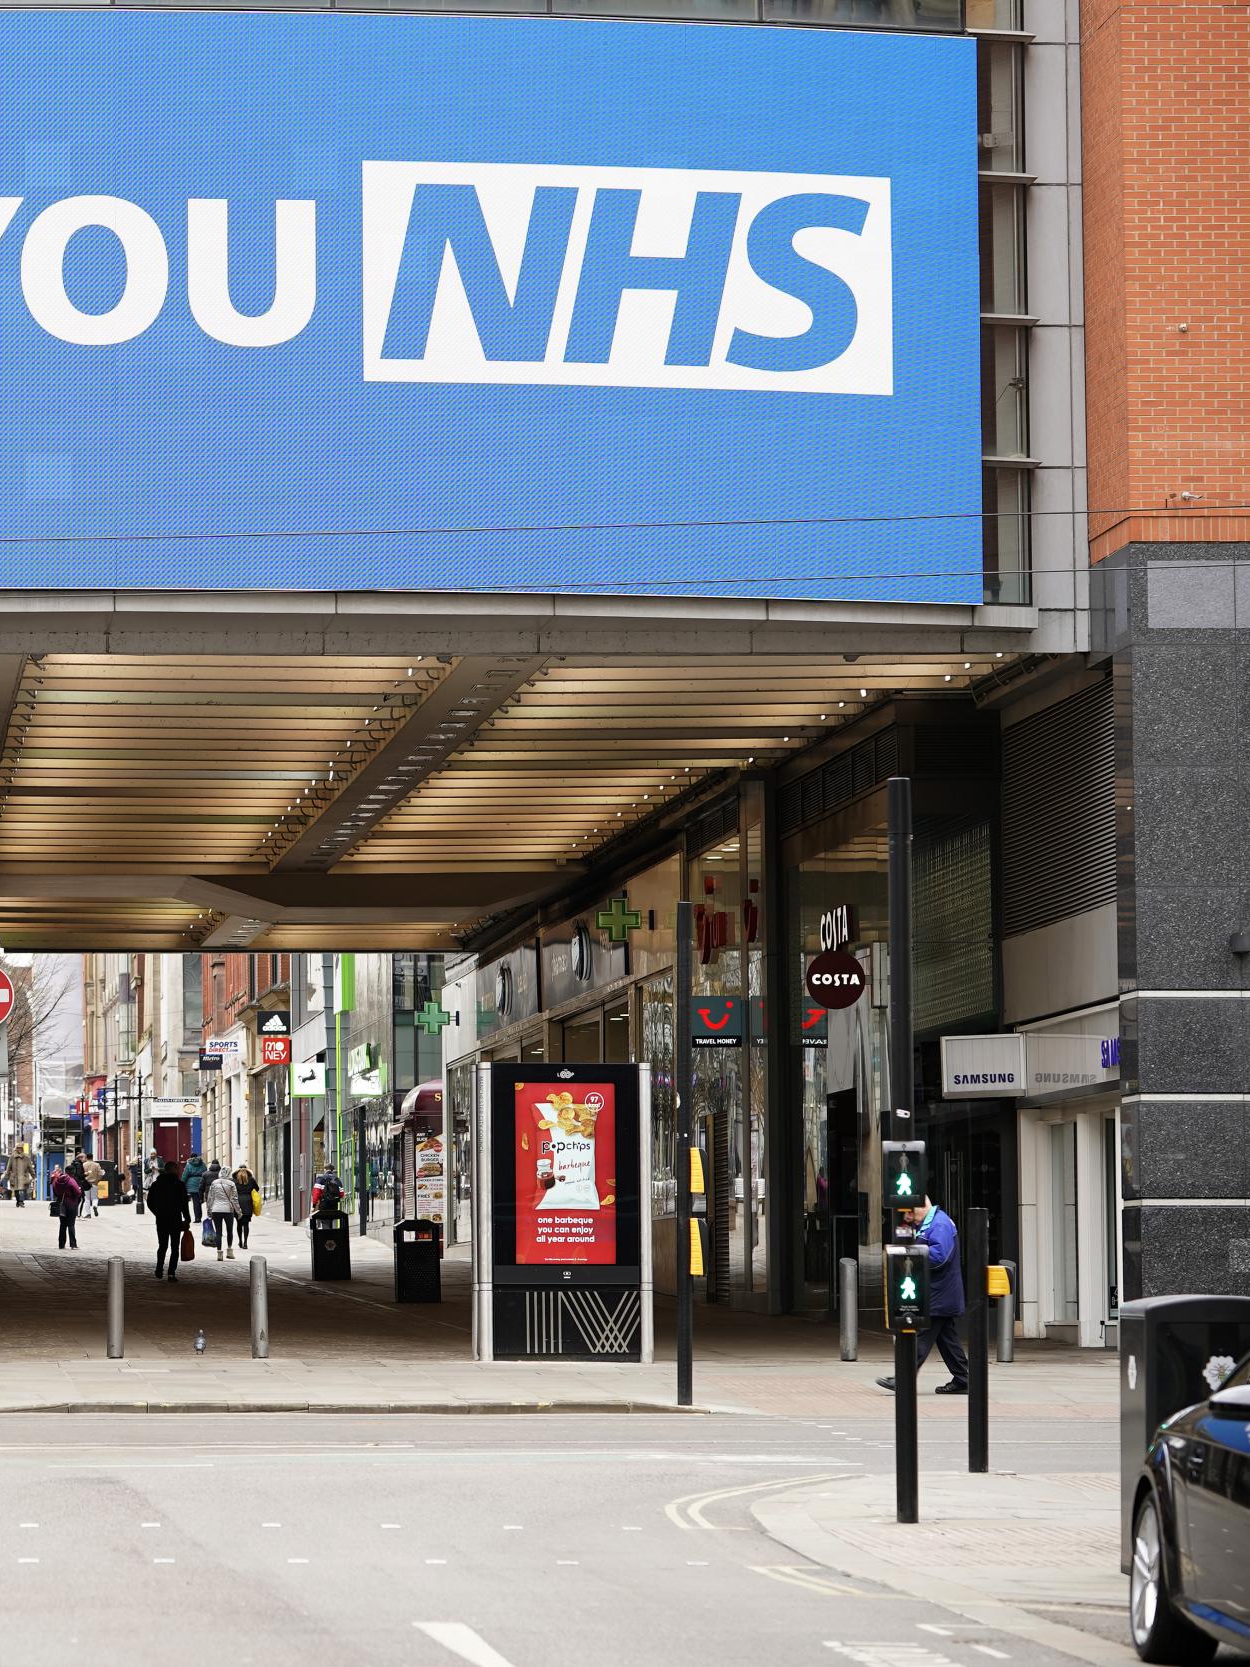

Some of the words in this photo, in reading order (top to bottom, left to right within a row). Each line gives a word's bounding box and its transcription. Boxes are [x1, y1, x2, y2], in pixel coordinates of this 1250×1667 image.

[378, 182, 871, 373] NHS
[819, 904, 849, 951] COSTA
[811, 973, 861, 987] COSTA
[953, 1073, 1015, 1085] SAMSUNG
[558, 1159, 591, 1174] barbeque
[554, 1216, 593, 1226] barbeque
[537, 1226, 553, 1235] you
[571, 1226, 593, 1235] enjoy
[536, 1235, 546, 1243] all
[547, 1236, 566, 1244] year
[567, 1235, 595, 1243] around
